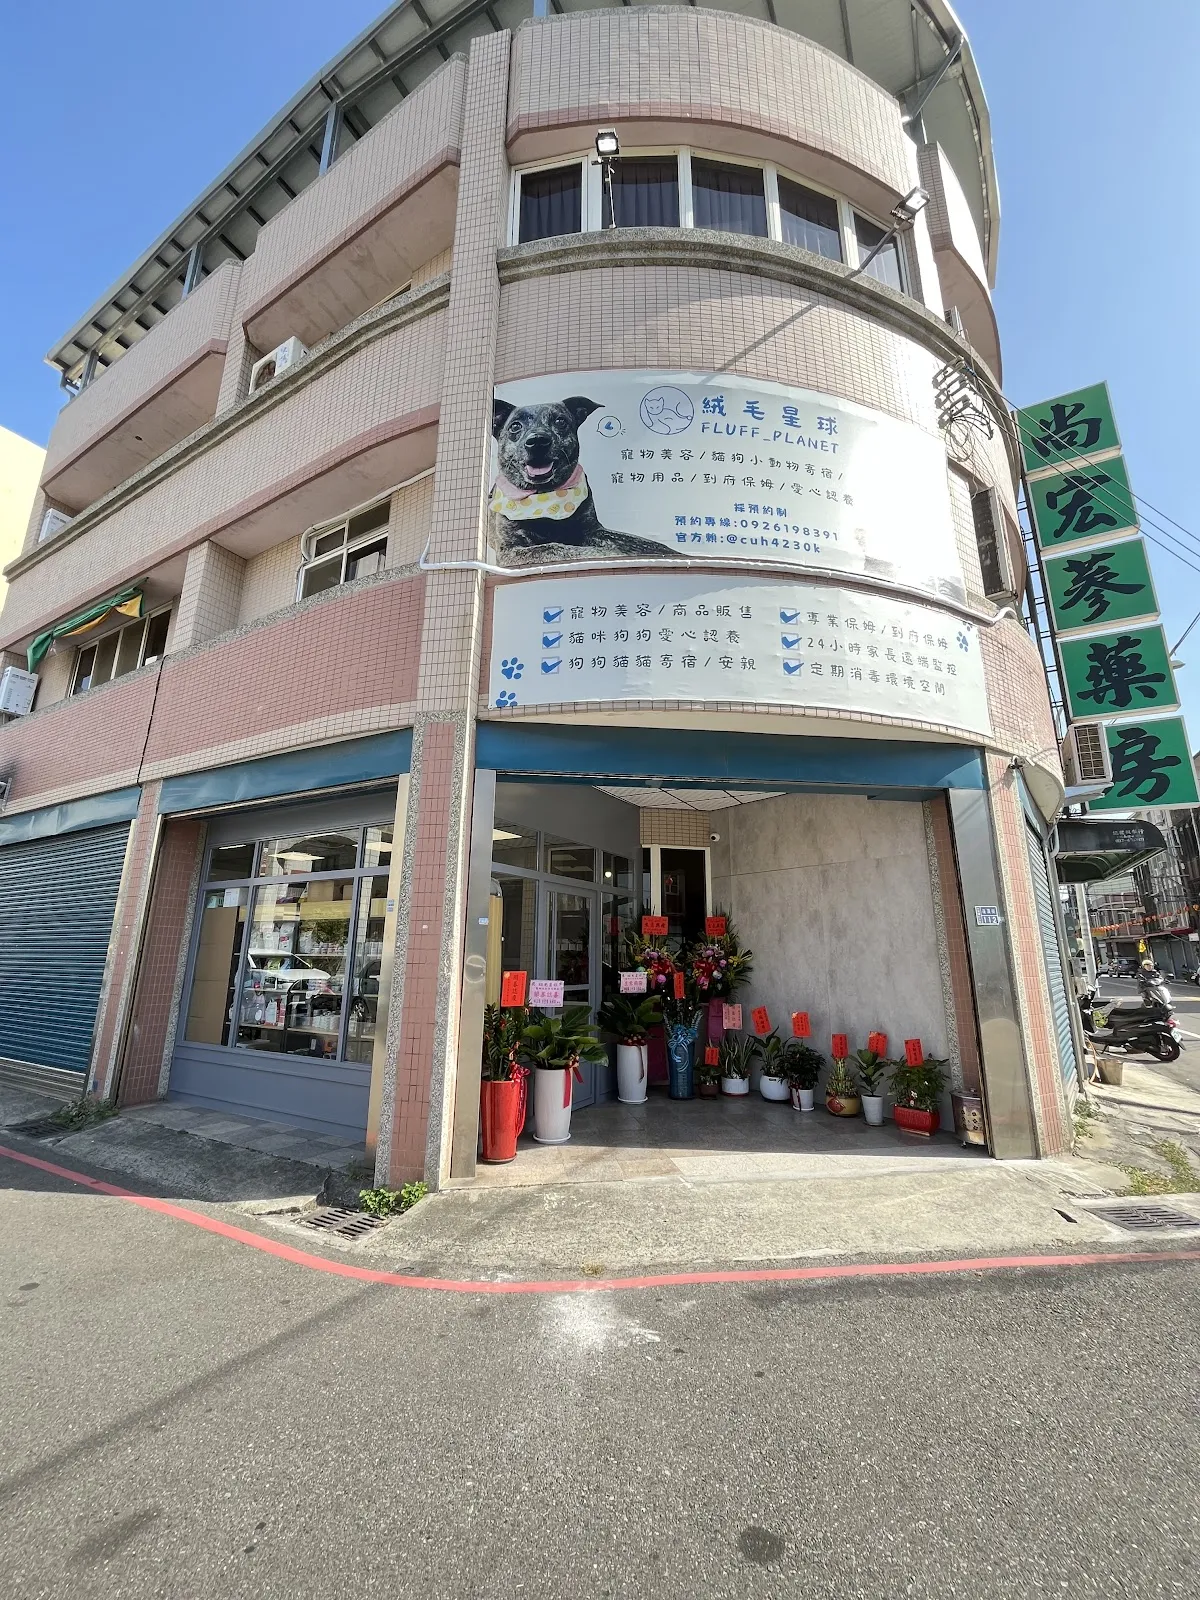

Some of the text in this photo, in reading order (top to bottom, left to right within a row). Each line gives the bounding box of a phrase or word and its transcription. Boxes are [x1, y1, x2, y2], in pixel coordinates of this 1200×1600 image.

[702, 395, 839, 436] 絨毛星球
[702, 422, 839, 454] FLUFF_PLANET
[733, 502, 789, 518] 採預約制
[674, 515, 839, 542] 預約專線:0926198391
[675, 532, 821, 554] 官方賴:@cuh4230k
[570, 603, 753, 620] 寵物美容/商品販售
[568, 628, 741, 645] 貓咪狗狗愛心認養
[807, 611, 949, 650] 專業保姆/到府保姆
[568, 653, 757, 670] 狗狗貓貓寄宿/安親
[807, 637, 957, 676] 24小時家長遠端監控
[810, 662, 946, 696] 定期消毒環境空間
